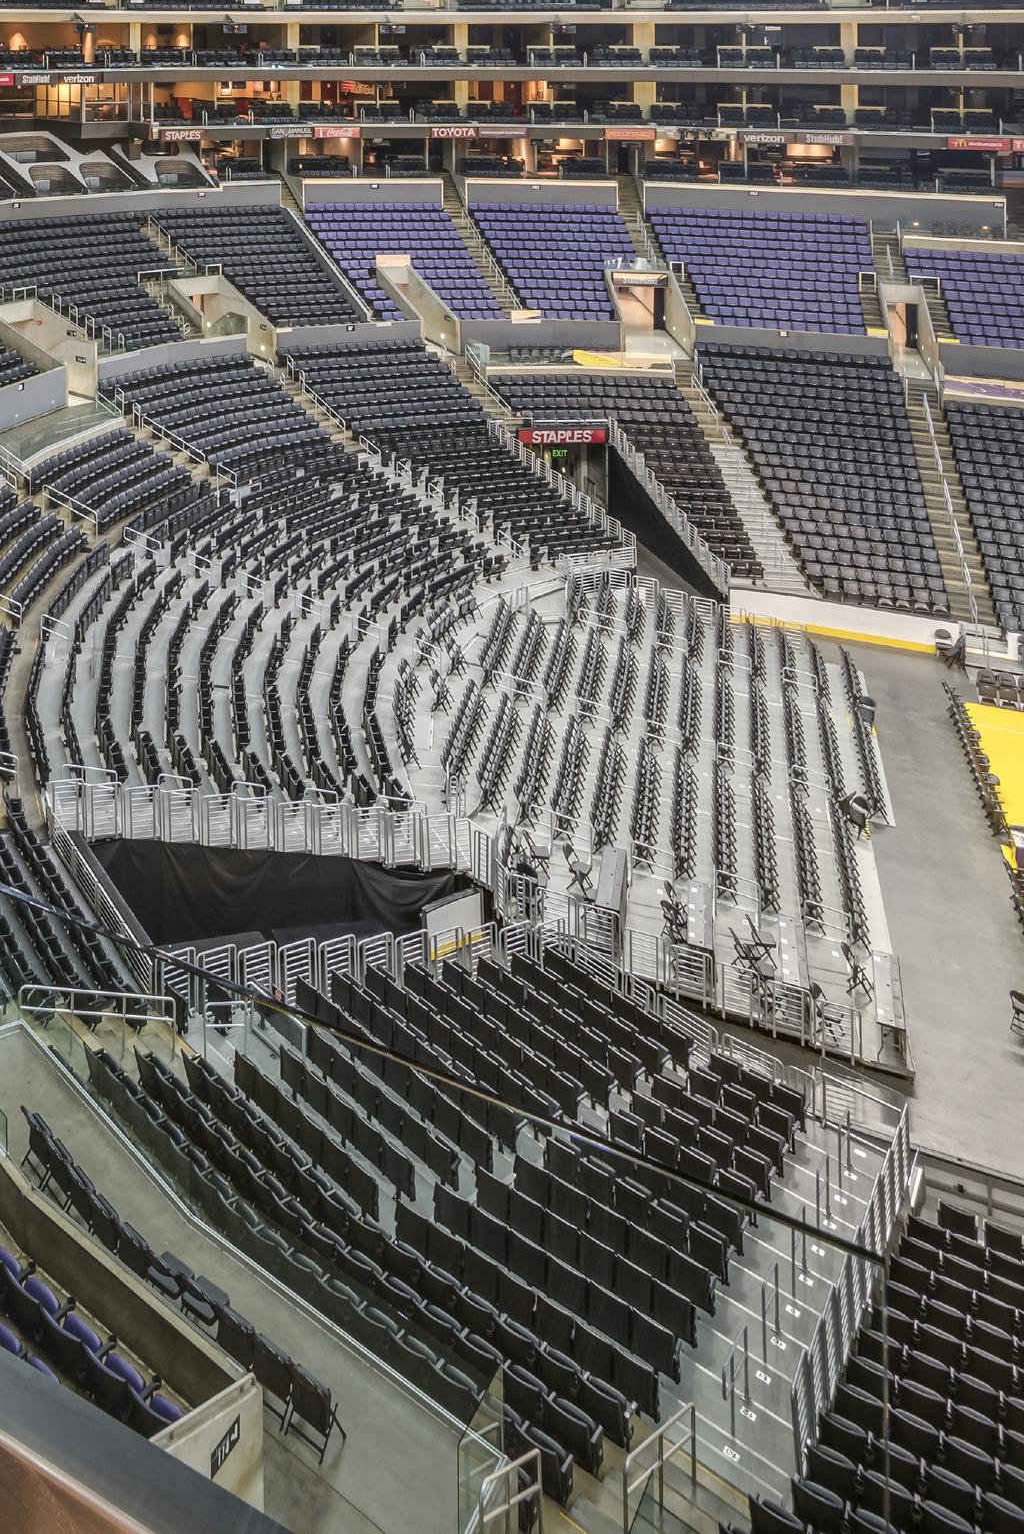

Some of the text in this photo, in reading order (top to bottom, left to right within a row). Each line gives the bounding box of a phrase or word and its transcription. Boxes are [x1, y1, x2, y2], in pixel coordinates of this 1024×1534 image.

[22, 75, 50, 83] StubHub!
[64, 74, 95, 83] verizon
[165, 129, 201, 140] STAPLES
[432, 128, 476, 137] TOYOTA
[744, 134, 785, 143] verizon
[806, 134, 843, 144] StubHub!
[532, 430, 592, 443] STAPLES
[553, 449, 568, 457] EXIT
